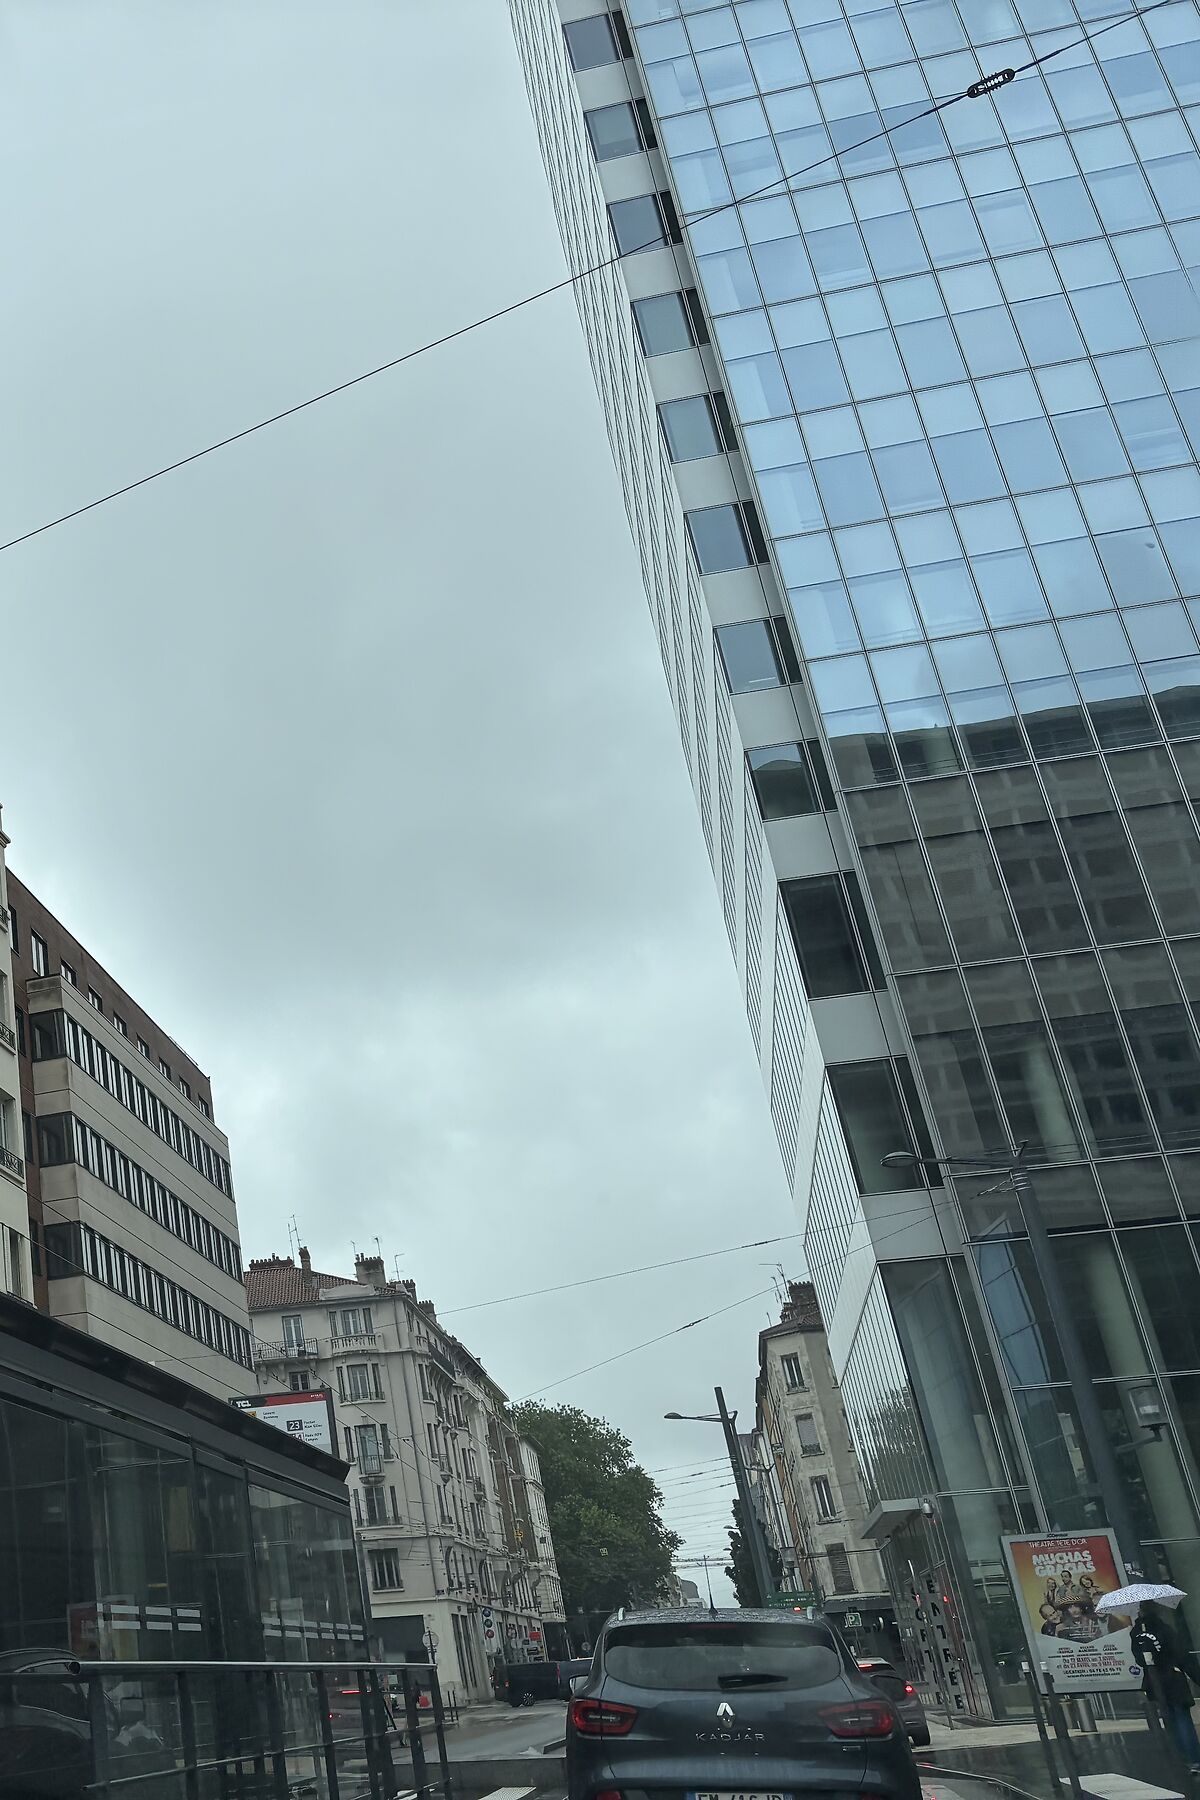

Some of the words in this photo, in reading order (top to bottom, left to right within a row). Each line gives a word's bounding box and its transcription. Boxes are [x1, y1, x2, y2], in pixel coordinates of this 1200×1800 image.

[289, 1421, 300, 1430] 23
[1032, 1550, 1092, 1566] MUCHAS
[695, 1733, 766, 1741] KADJAR
